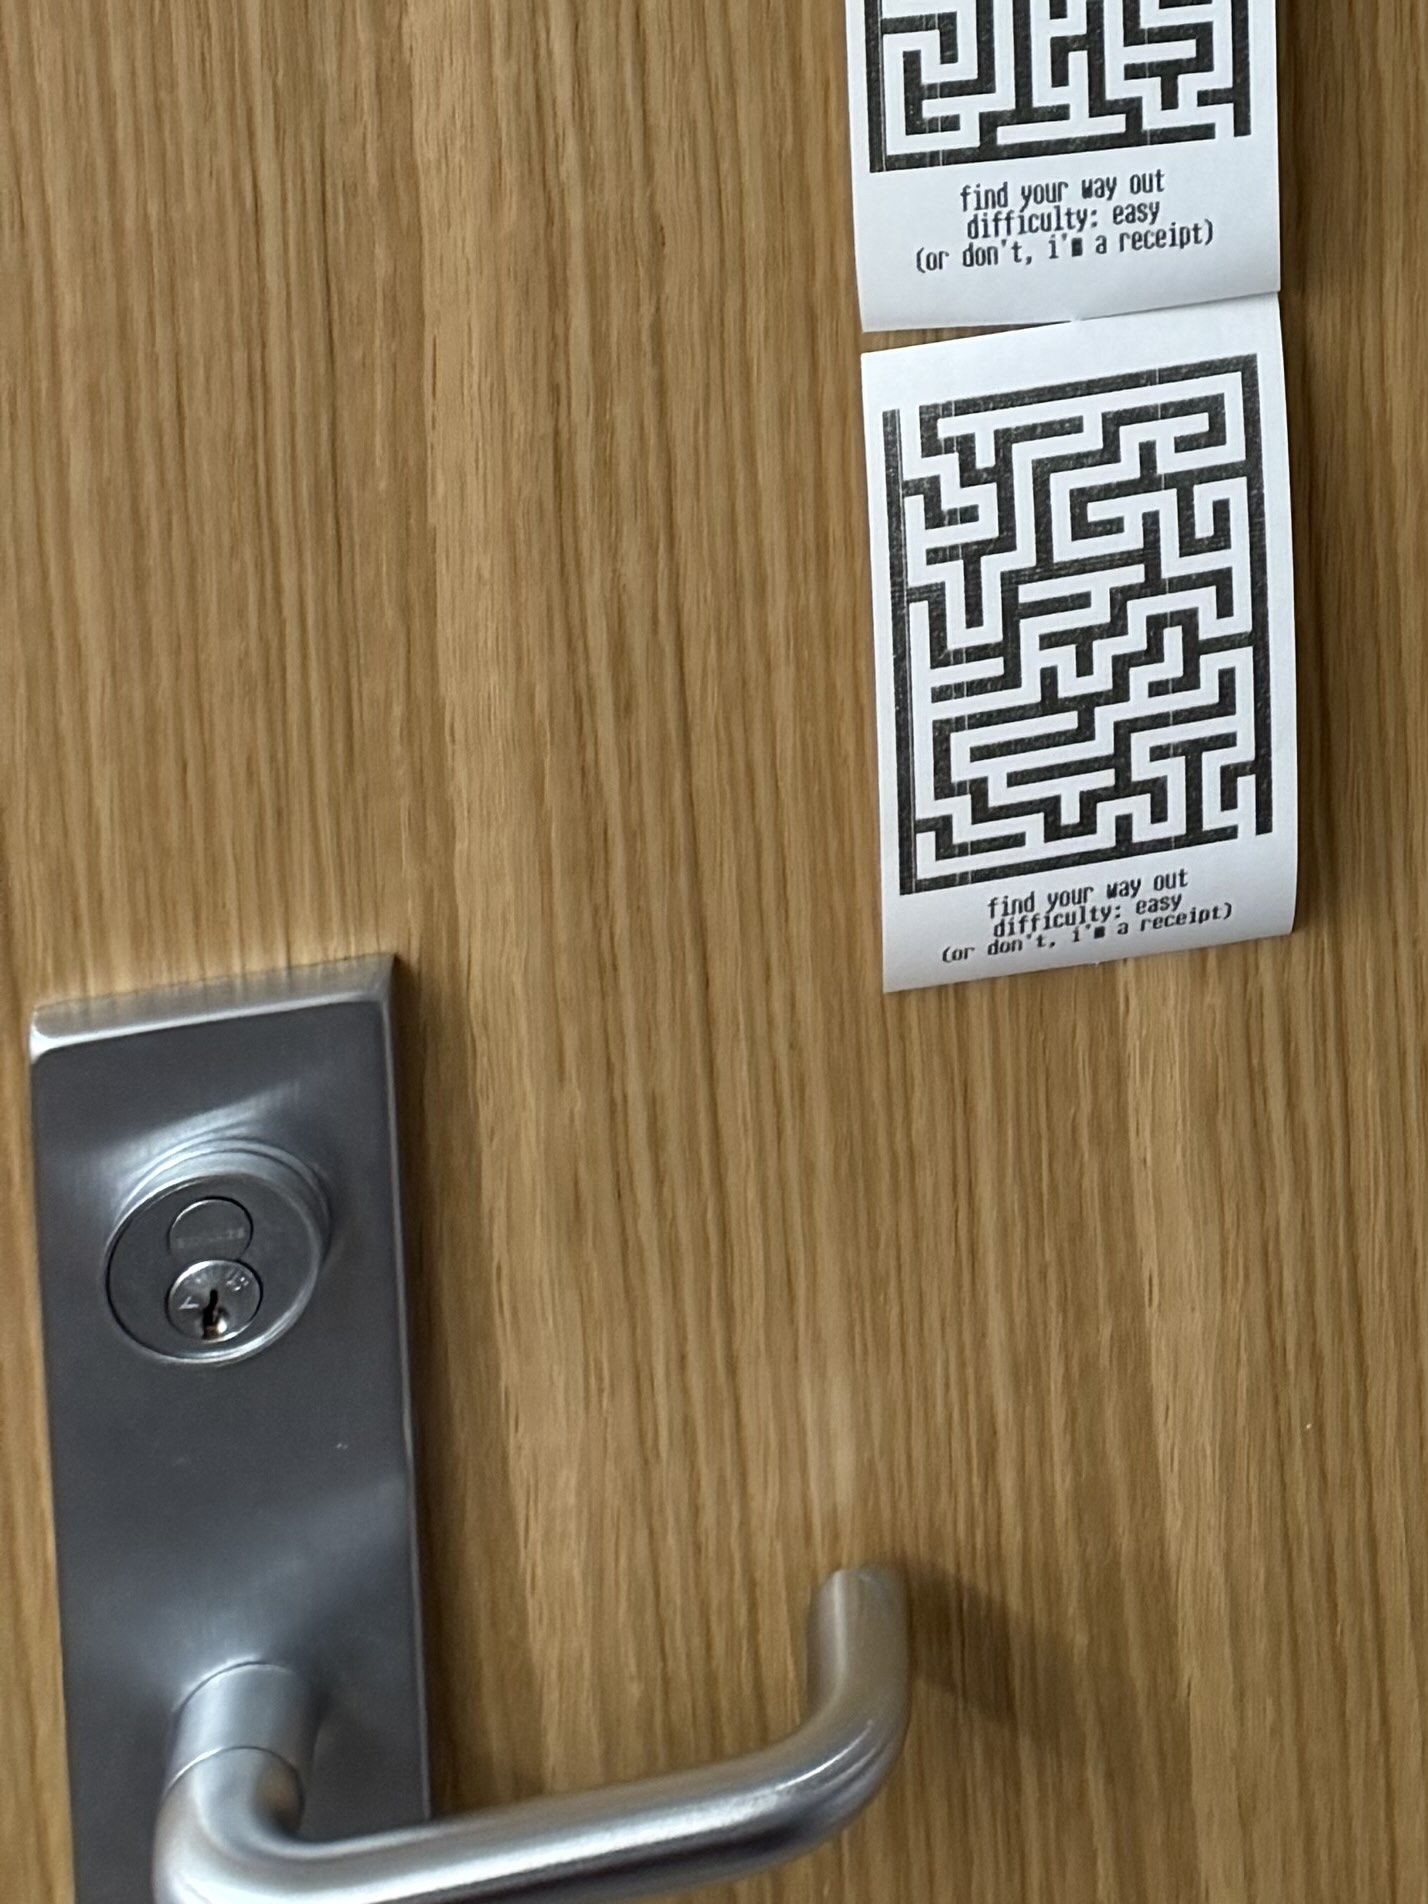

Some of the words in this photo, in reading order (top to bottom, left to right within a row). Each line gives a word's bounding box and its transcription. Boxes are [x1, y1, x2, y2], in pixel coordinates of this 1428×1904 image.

[960, 182, 1008, 212] find
[1021, 182, 1068, 210] your
[1082, 177, 1117, 201] way
[1130, 169, 1164, 195] out
[967, 205, 1097, 239] difficulty:
[1113, 201, 1160, 225] easy
[988, 891, 1035, 918] find
[1047, 887, 1094, 913] your
[1154, 869, 1188, 891] out
[993, 905, 1120, 937] difficulty:
[1136, 894, 1182, 915] easy
